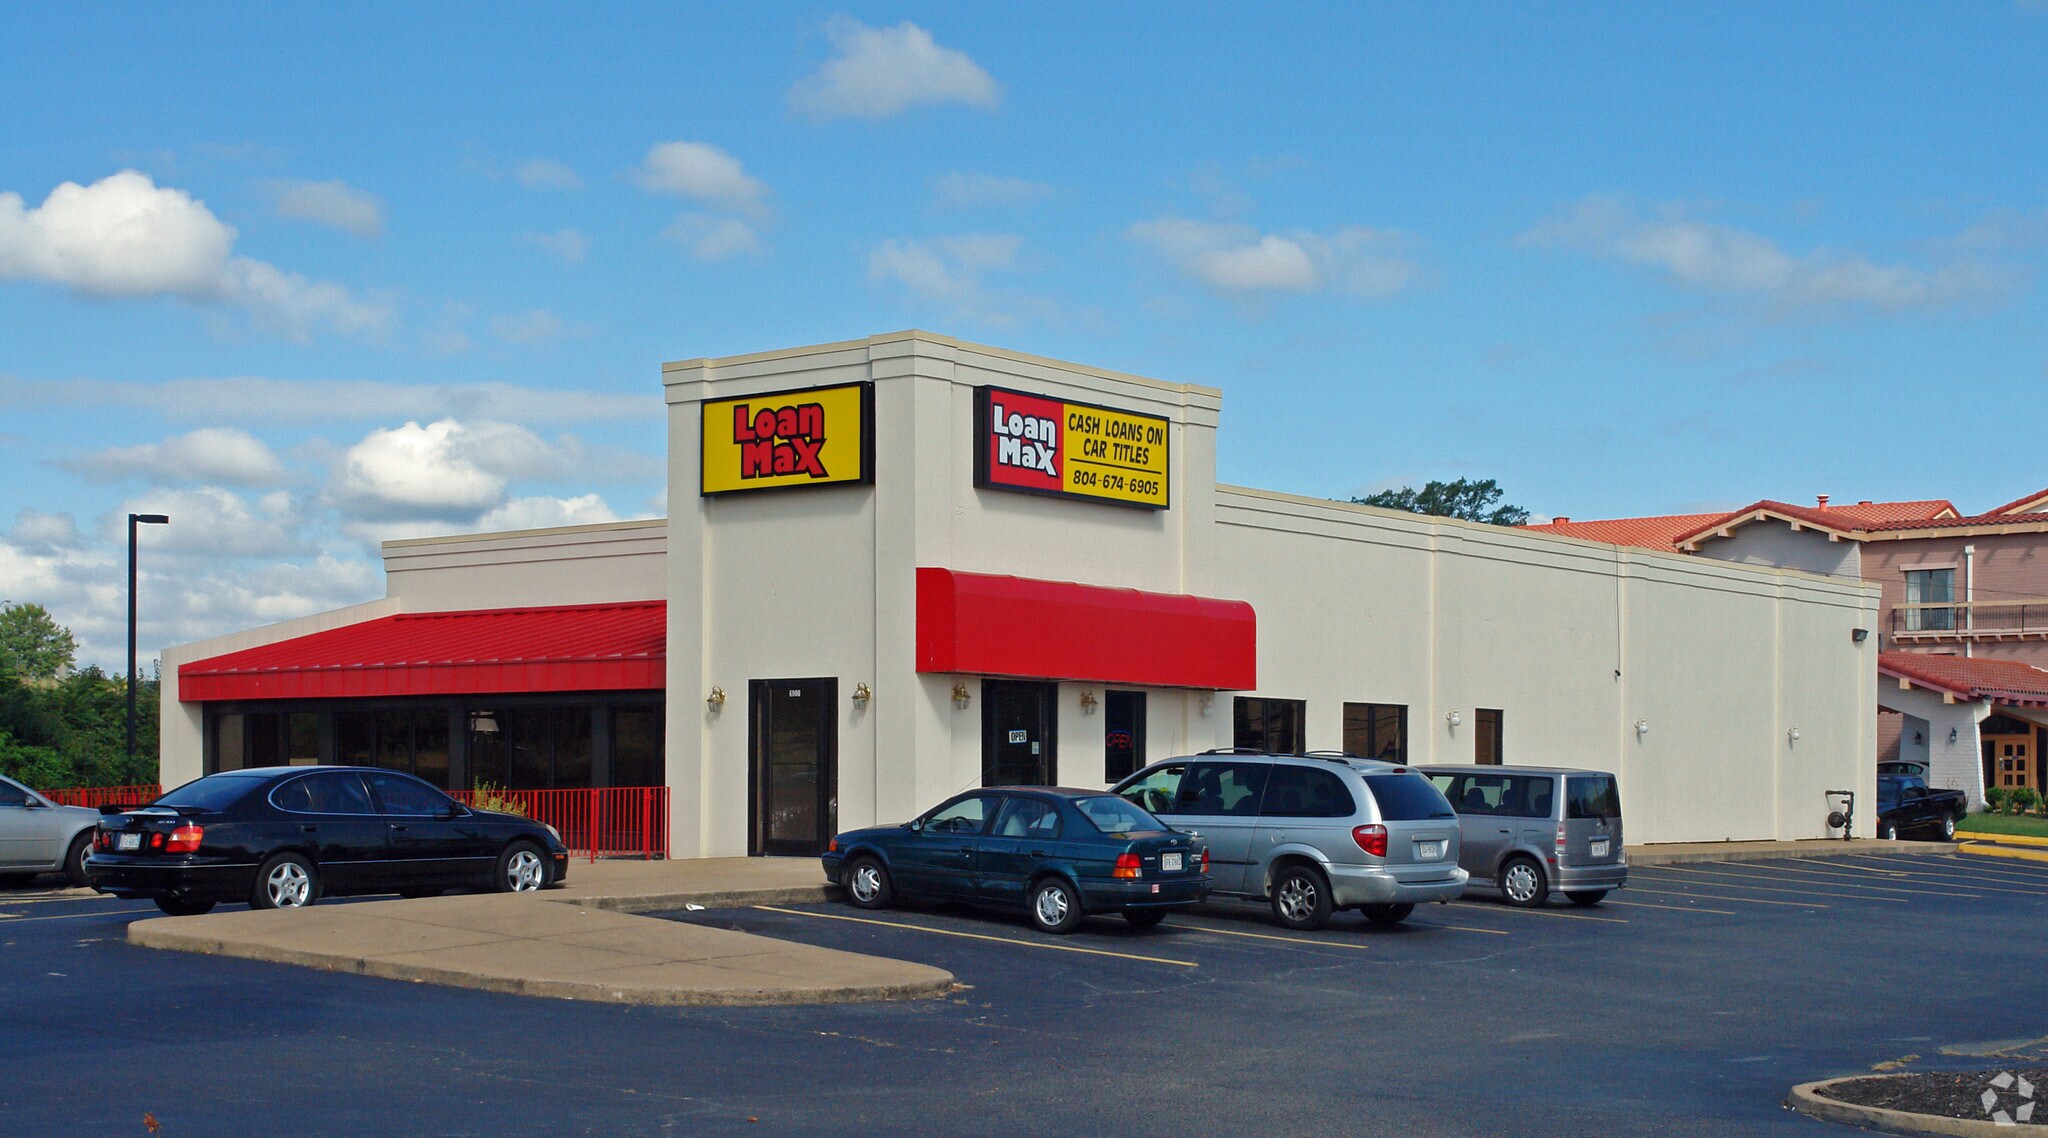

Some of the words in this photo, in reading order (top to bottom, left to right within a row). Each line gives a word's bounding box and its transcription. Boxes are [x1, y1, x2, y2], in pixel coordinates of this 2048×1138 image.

[733, 402, 824, 445] Loan
[993, 402, 1057, 449] Loan
[1068, 413, 1101, 436] CASH
[1105, 419, 1143, 443] LOANS
[1146, 426, 1163, 446] ON
[1083, 438, 1107, 459] CAR
[1113, 442, 1150, 466] TITLES
[1073, 470, 1159, 496] 804-674-6905
[1010, 731, 1026, 741] OPEN
[1106, 732, 1133, 748] OPEN
